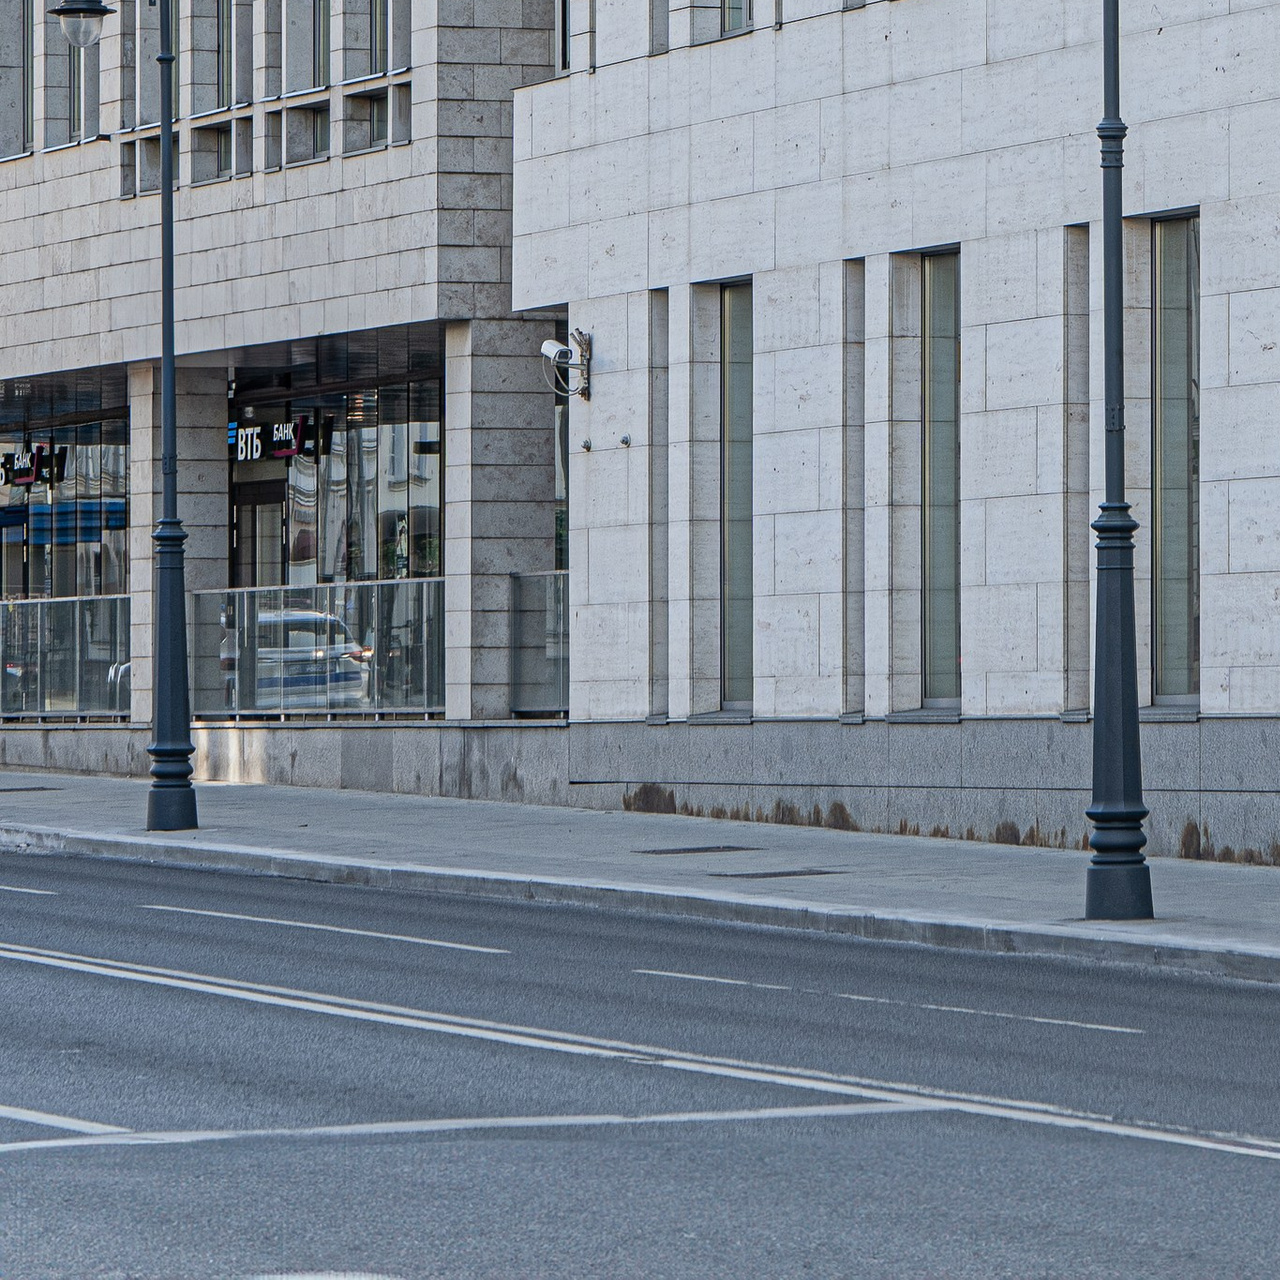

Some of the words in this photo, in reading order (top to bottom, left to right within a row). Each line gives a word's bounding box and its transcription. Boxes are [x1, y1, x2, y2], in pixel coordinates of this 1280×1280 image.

[238, 427, 262, 460] ВТБ
[273, 423, 294, 441] БАНК
[14, 452, 31, 470] БАНК
